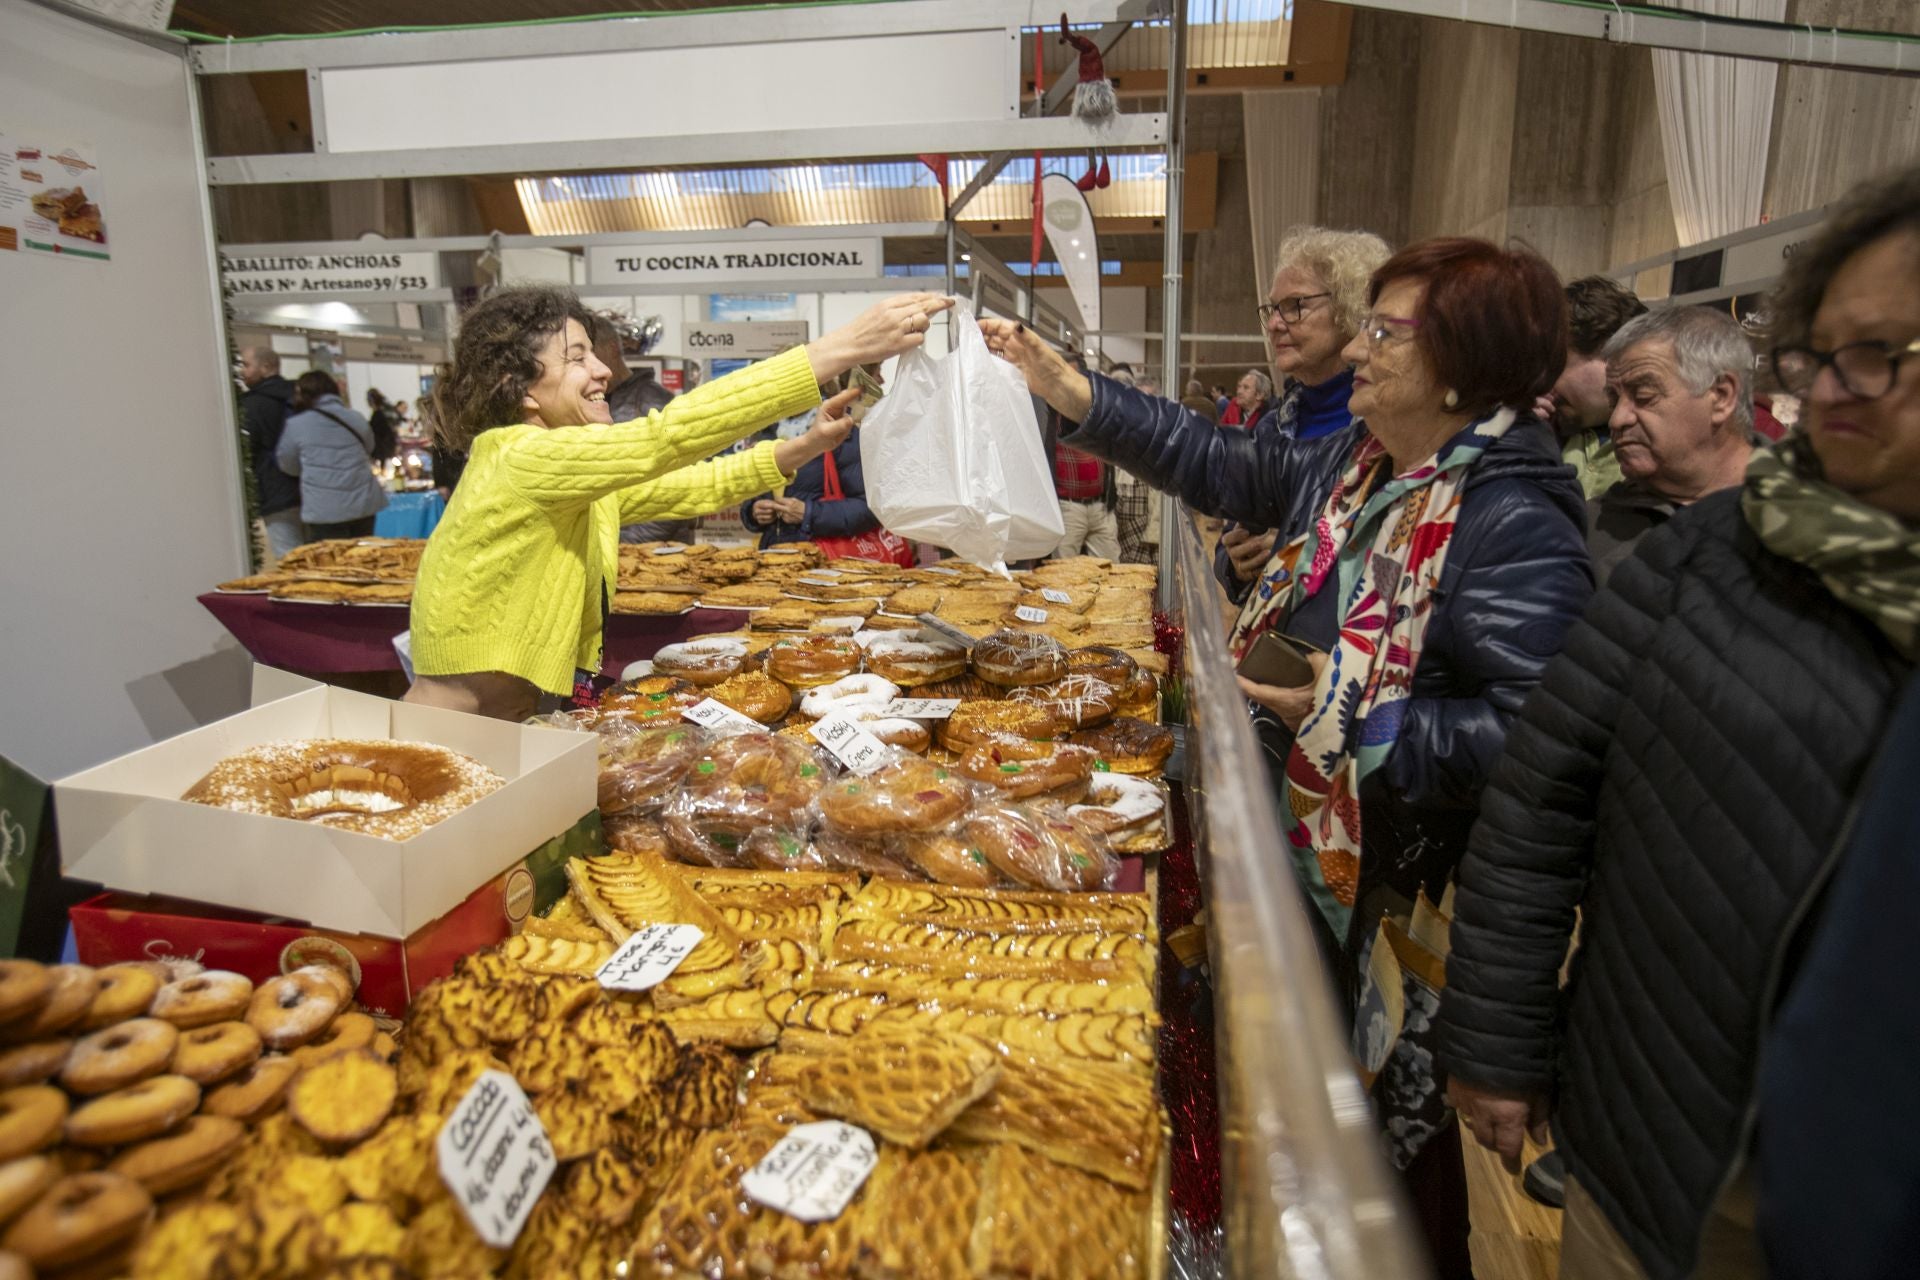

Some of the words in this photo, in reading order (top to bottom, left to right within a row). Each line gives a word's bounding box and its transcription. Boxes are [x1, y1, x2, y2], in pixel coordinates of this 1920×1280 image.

[317, 255, 402, 271] ANCHOAS
[616, 258, 641, 272] TU
[646, 255, 720, 271] COCINA
[724, 251, 863, 269] TRADICIONAL
